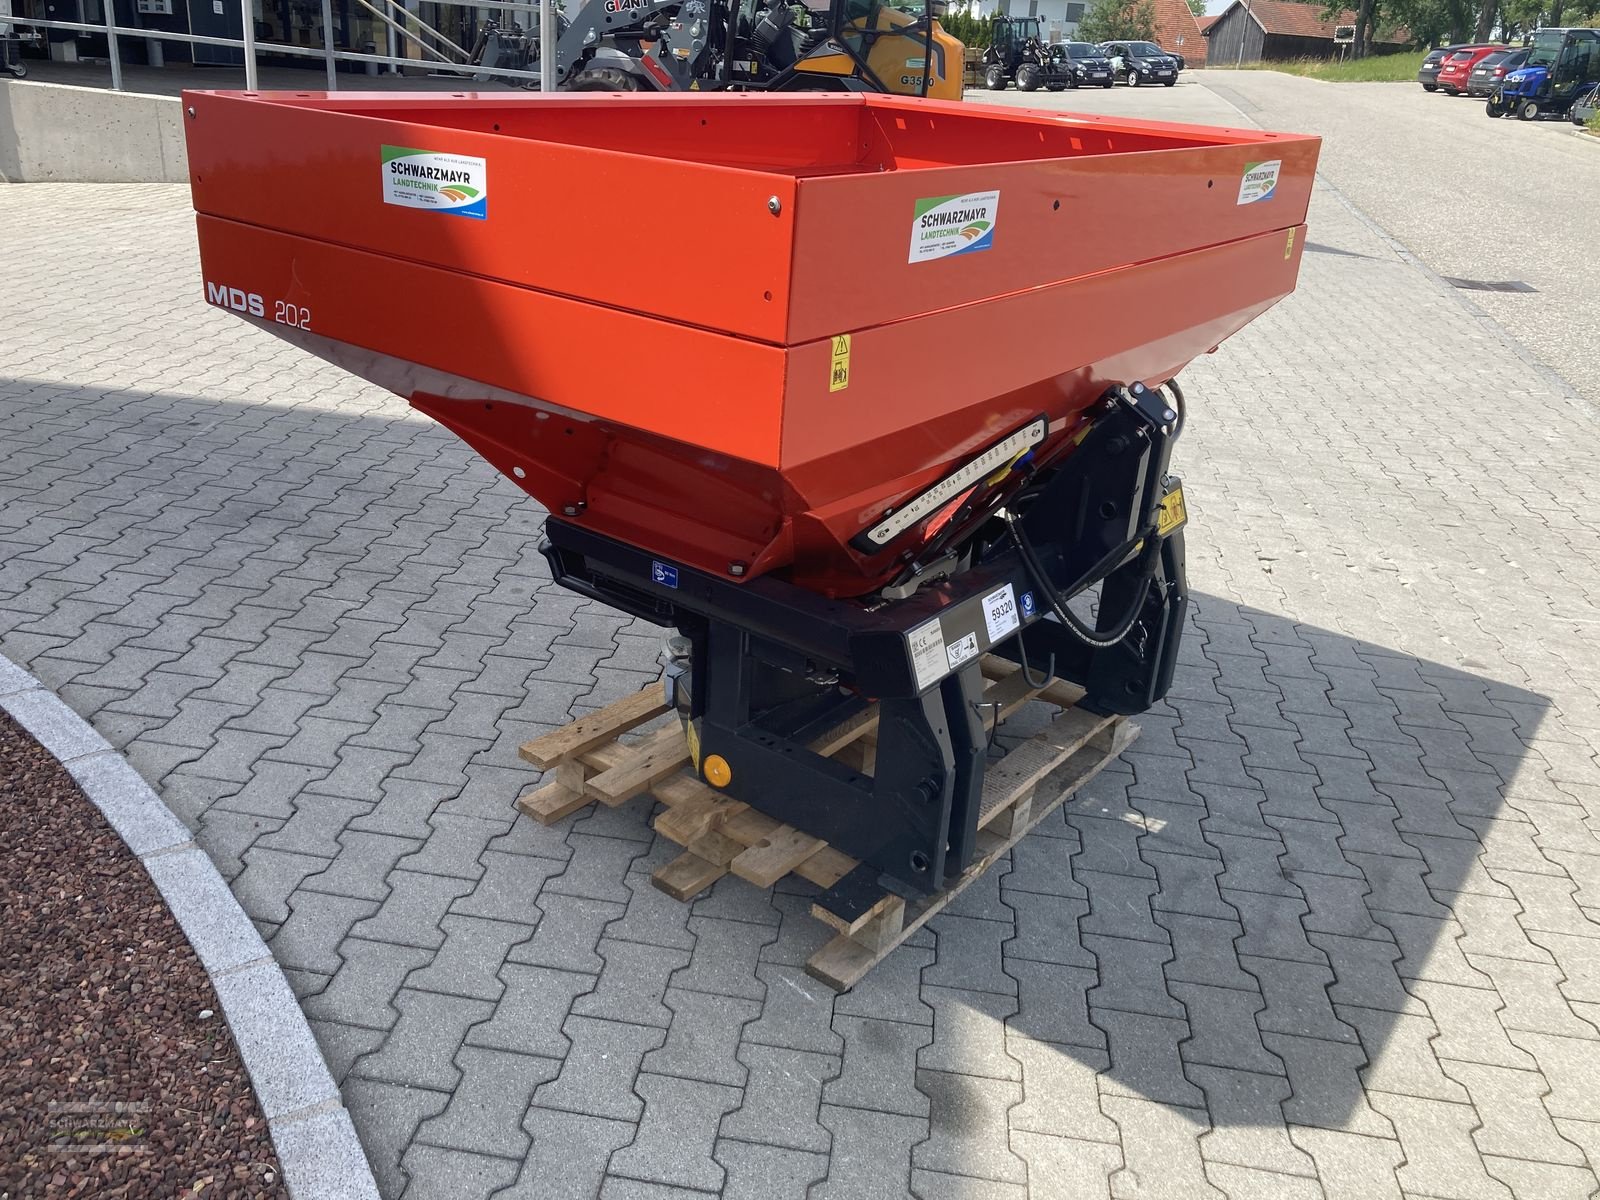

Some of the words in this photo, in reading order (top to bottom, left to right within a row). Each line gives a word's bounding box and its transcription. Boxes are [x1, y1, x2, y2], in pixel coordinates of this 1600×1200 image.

[605, 0, 648, 13] GIANT
[901, 75, 934, 87] G350
[390, 161, 471, 184] SCHWARZMAYR
[392, 177, 439, 192] LANDTECHNIK
[920, 207, 987, 228] SCHWARZMAYR
[920, 227, 960, 241] LANDTECHNIK
[207, 281, 265, 317] MDS
[275, 300, 311, 331] 20.2
[991, 599, 1013, 621] 59320
